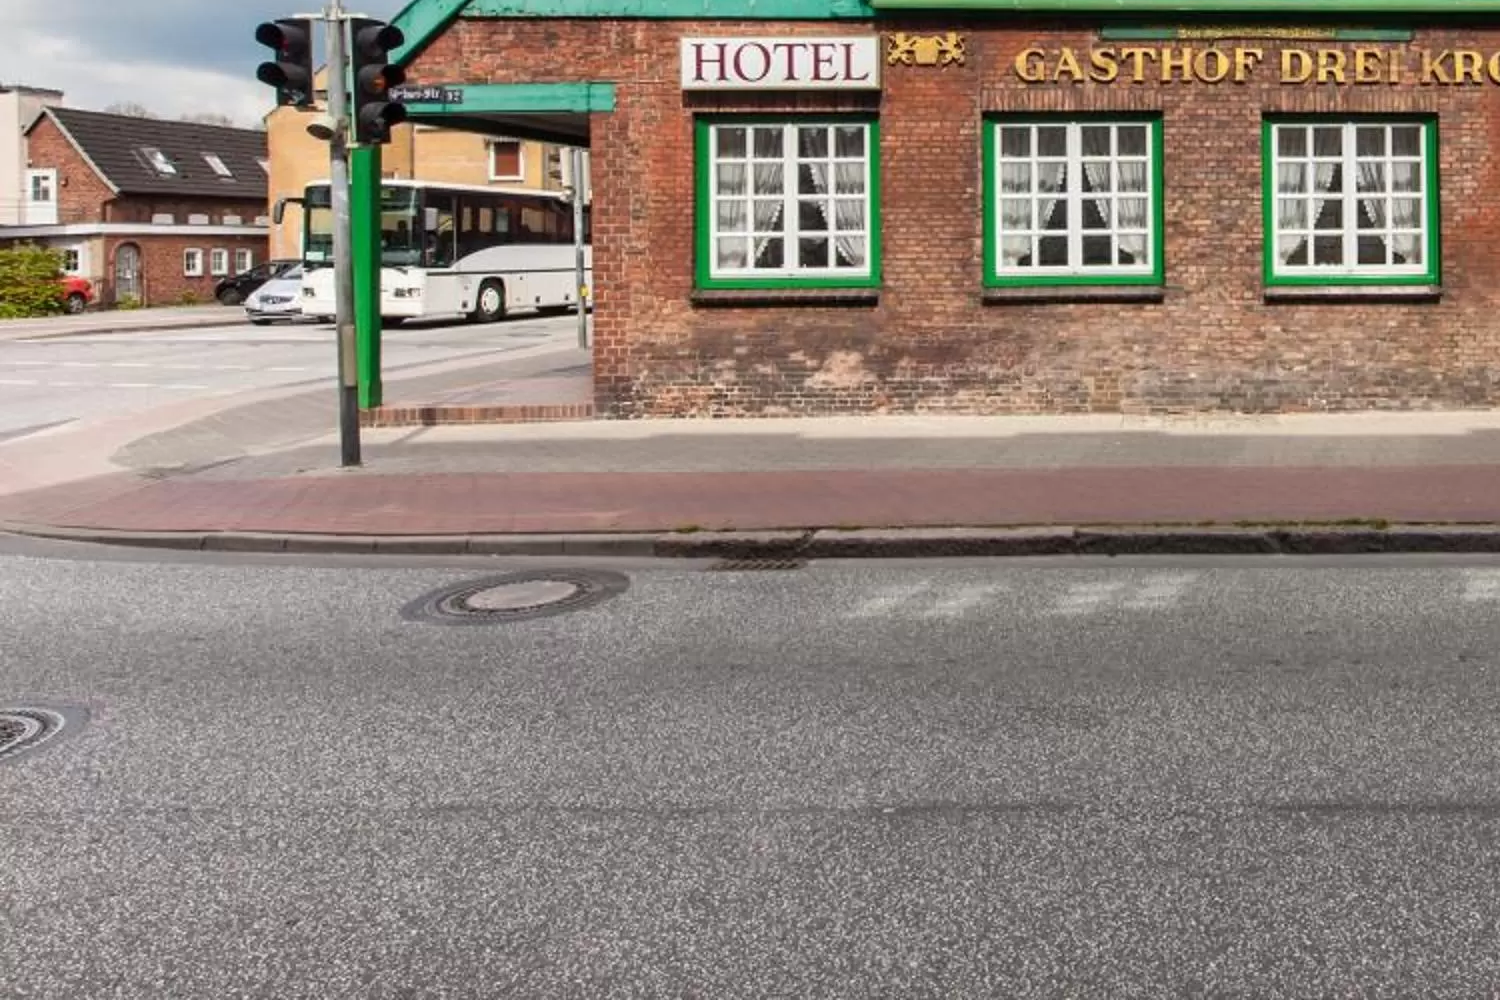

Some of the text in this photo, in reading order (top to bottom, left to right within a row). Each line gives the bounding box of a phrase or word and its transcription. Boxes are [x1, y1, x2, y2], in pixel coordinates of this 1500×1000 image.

[691, 41, 869, 82] HOTEL
[1015, 47, 1263, 83] GASTHOF
[1280, 49, 1401, 84] DREI
